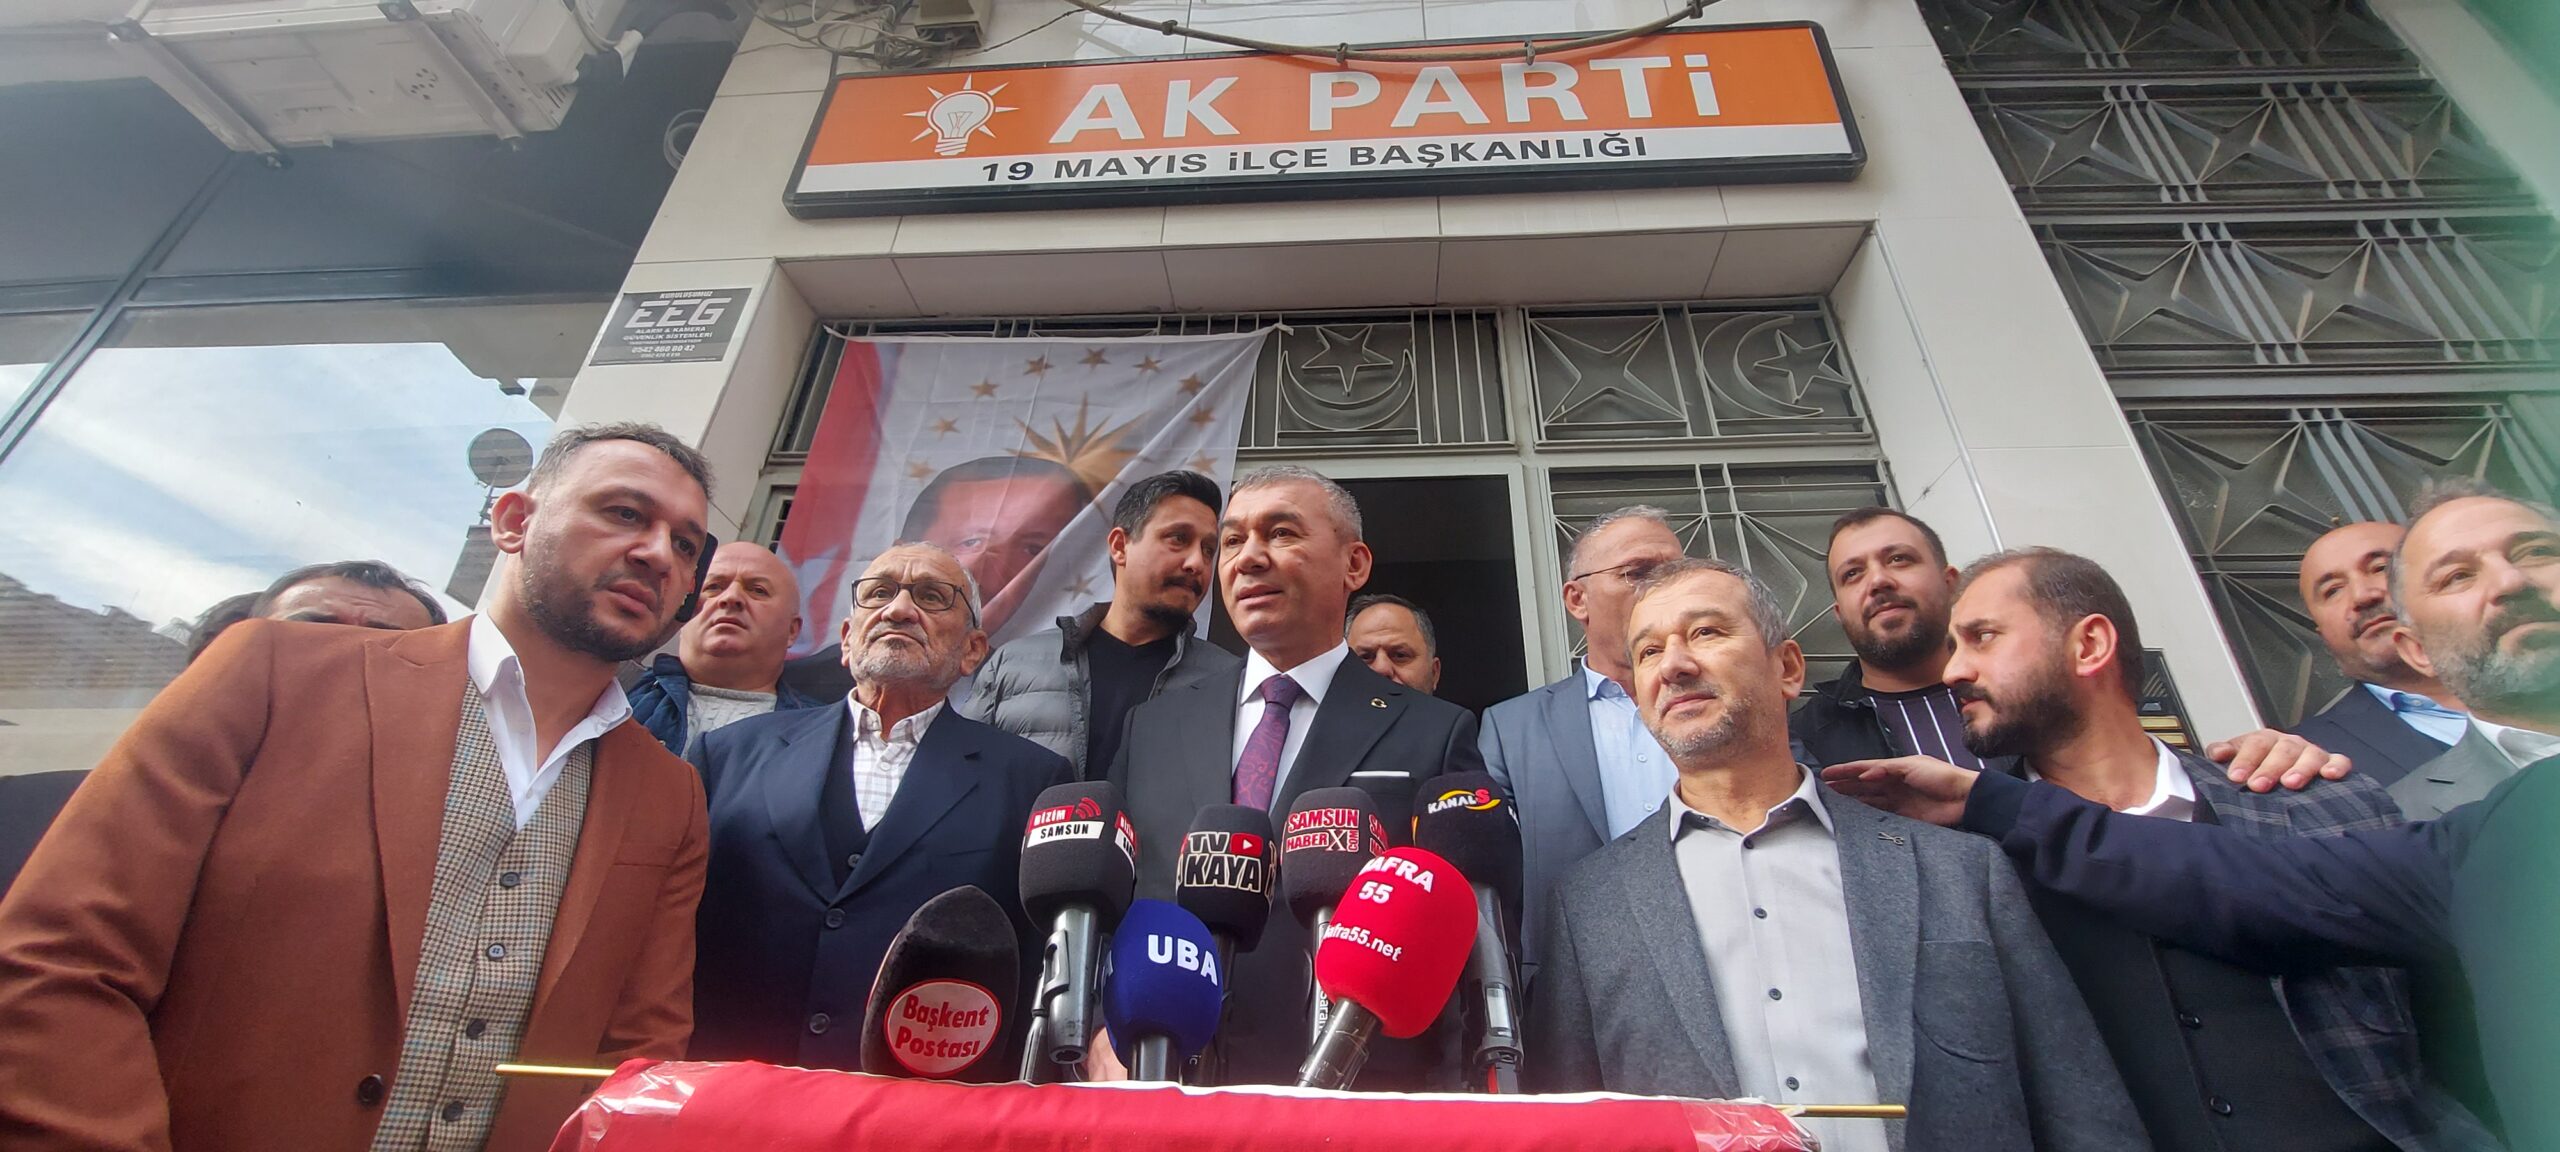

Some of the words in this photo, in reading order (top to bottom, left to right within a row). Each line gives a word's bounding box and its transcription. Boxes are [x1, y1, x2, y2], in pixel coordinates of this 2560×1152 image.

[1048, 77, 1241, 144] AK
[982, 161, 1034, 182] 19
[1053, 153, 1208, 179] MAYIS
[1349, 132, 1647, 168] BAŞKANLIĞI
[624, 297, 732, 328] EEG
[1040, 823, 1089, 839] SAMSUN
[1288, 808, 1359, 833] SAMSUN
[1188, 831, 1230, 853] TV
[1184, 853, 1261, 893] KAYA
[1358, 881, 1394, 904] 55
[1148, 934, 1218, 986] UBA
[903, 995, 990, 1032] Başkent
[895, 1026, 981, 1058] Postası
